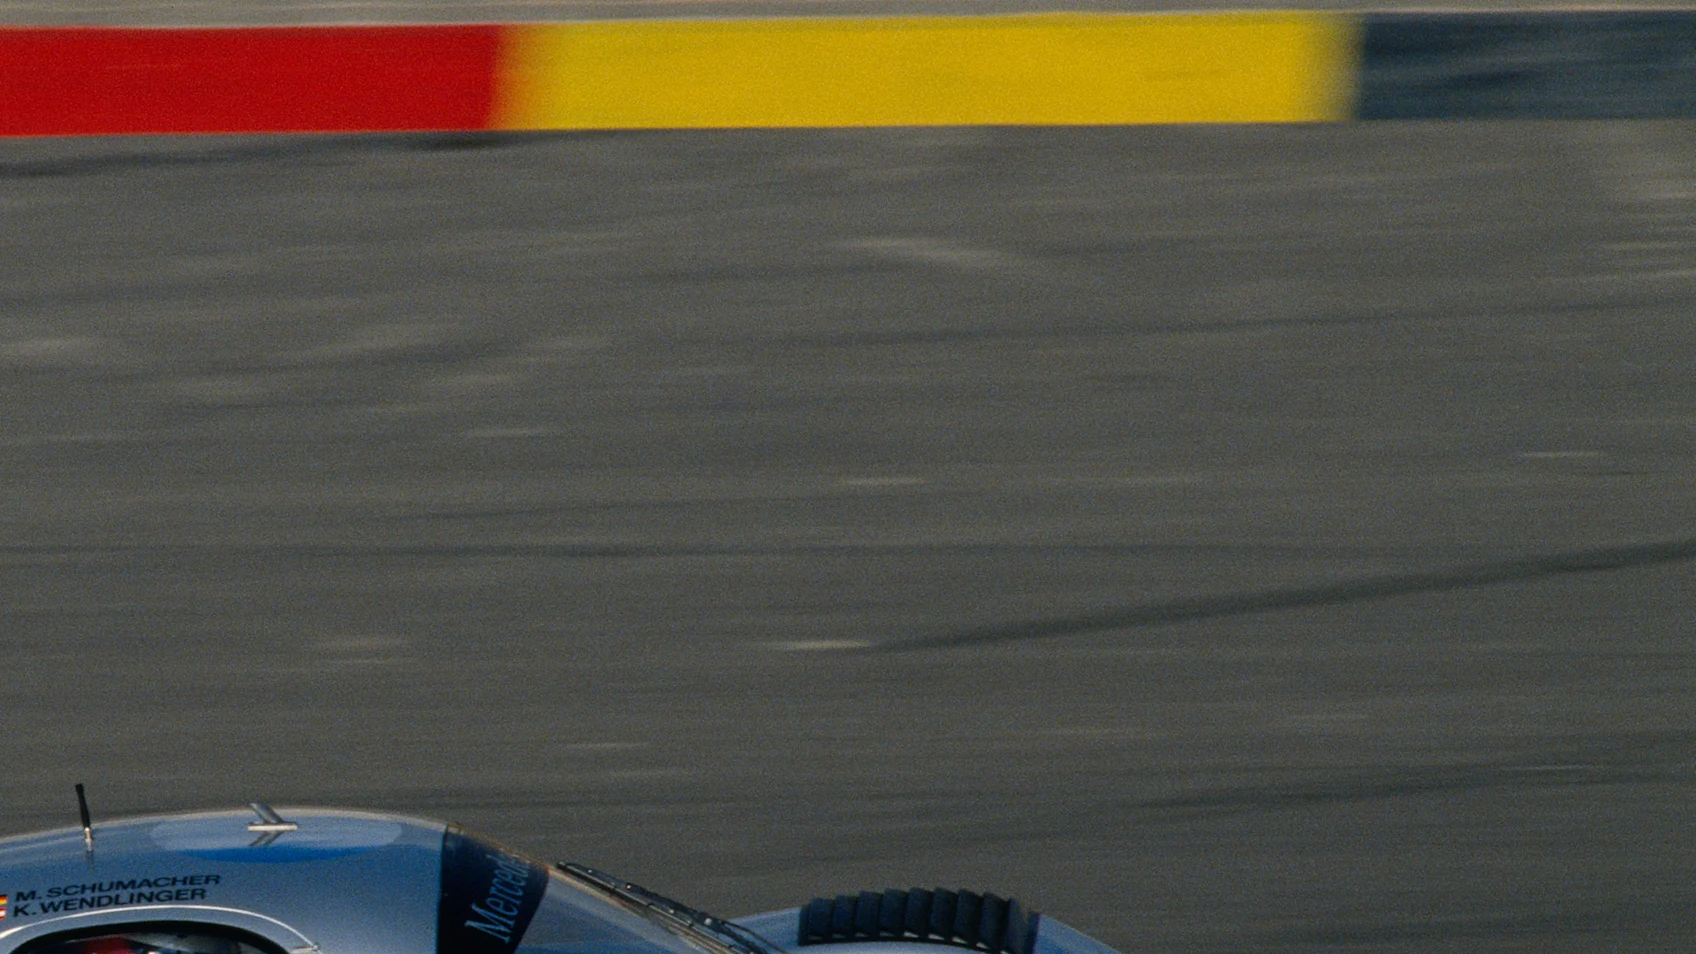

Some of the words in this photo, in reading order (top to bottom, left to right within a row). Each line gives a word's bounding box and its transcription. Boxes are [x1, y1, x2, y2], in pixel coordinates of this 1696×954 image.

[15, 891, 41, 901] M.
[46, 874, 221, 898] SCHUMACHER
[465, 854, 531, 944] Merced
